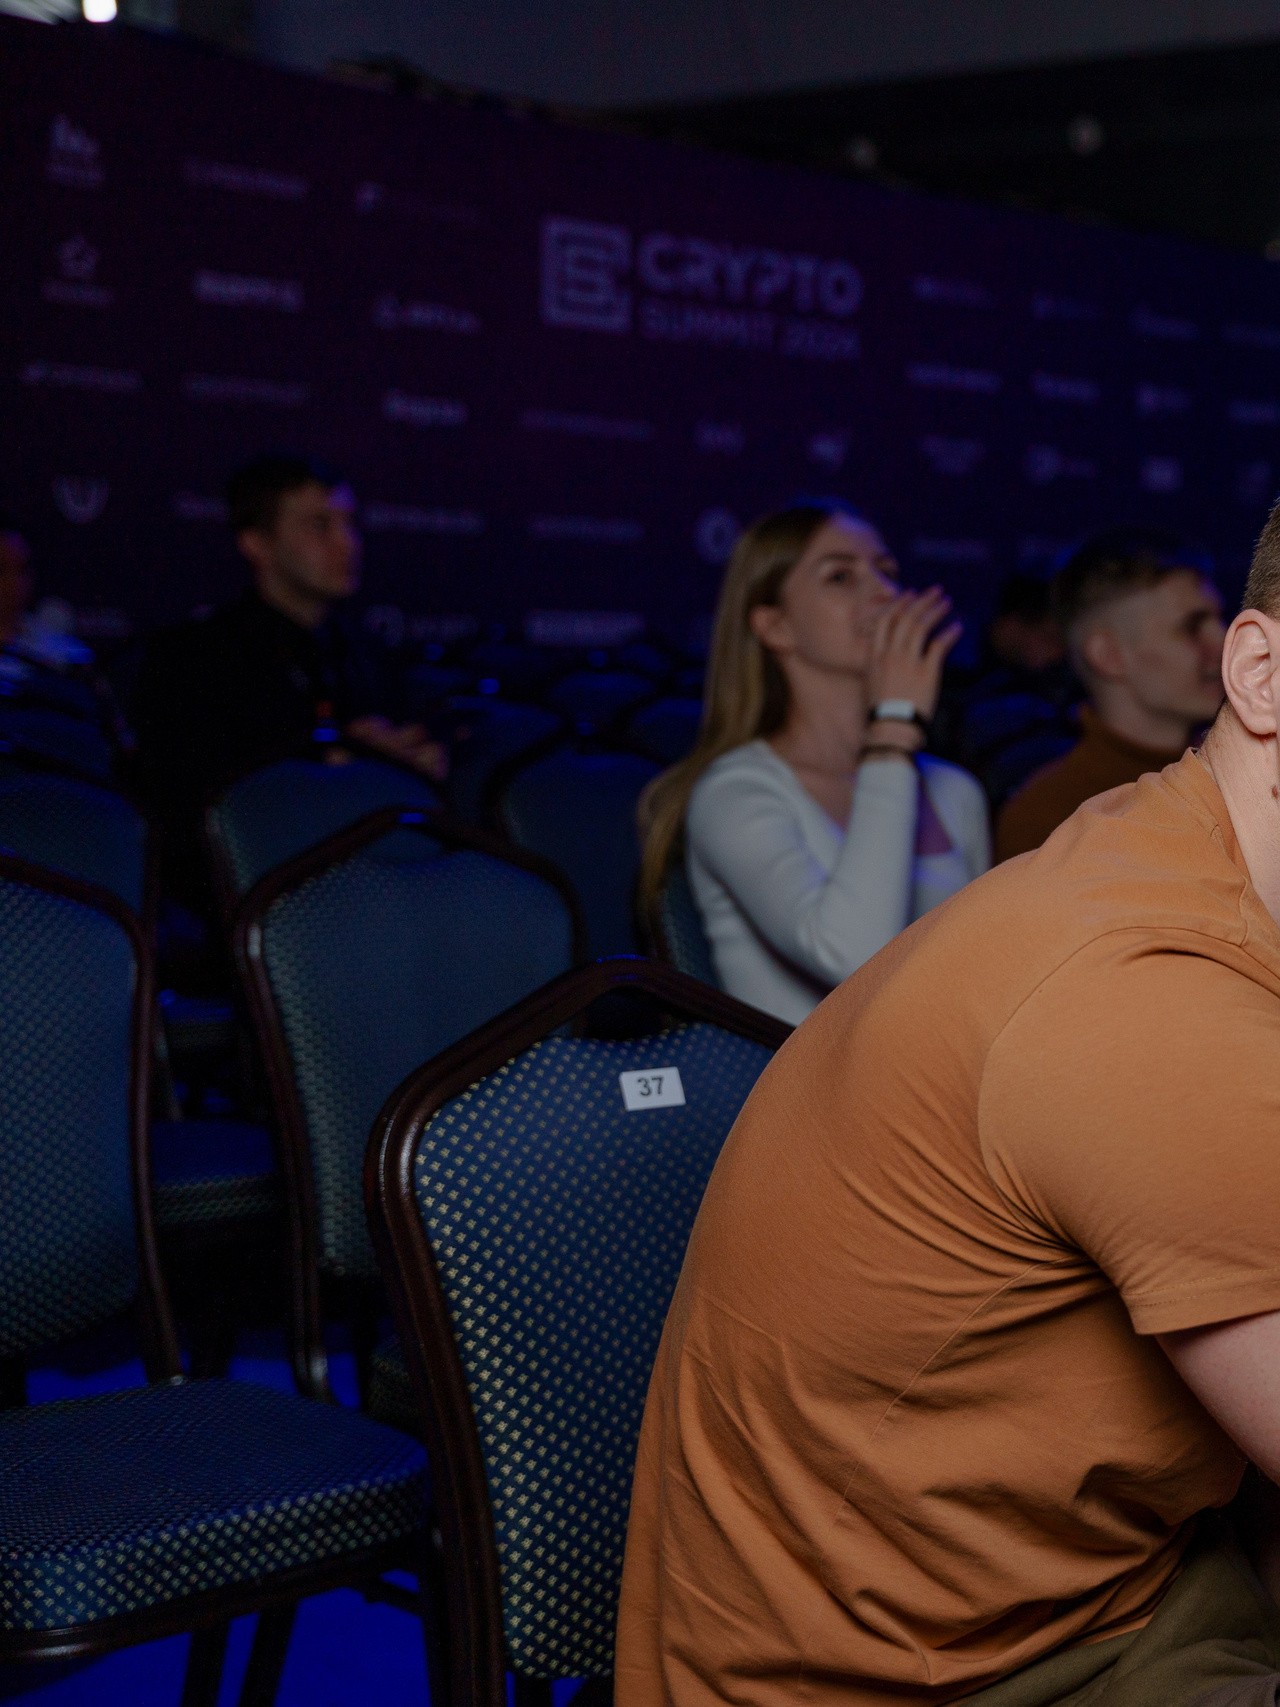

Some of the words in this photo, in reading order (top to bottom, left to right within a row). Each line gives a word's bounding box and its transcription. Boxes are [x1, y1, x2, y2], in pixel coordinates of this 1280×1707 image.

[638, 231, 864, 318] CRYPTO
[640, 300, 774, 349] SUMMIT
[637, 1076, 664, 1097] 37
